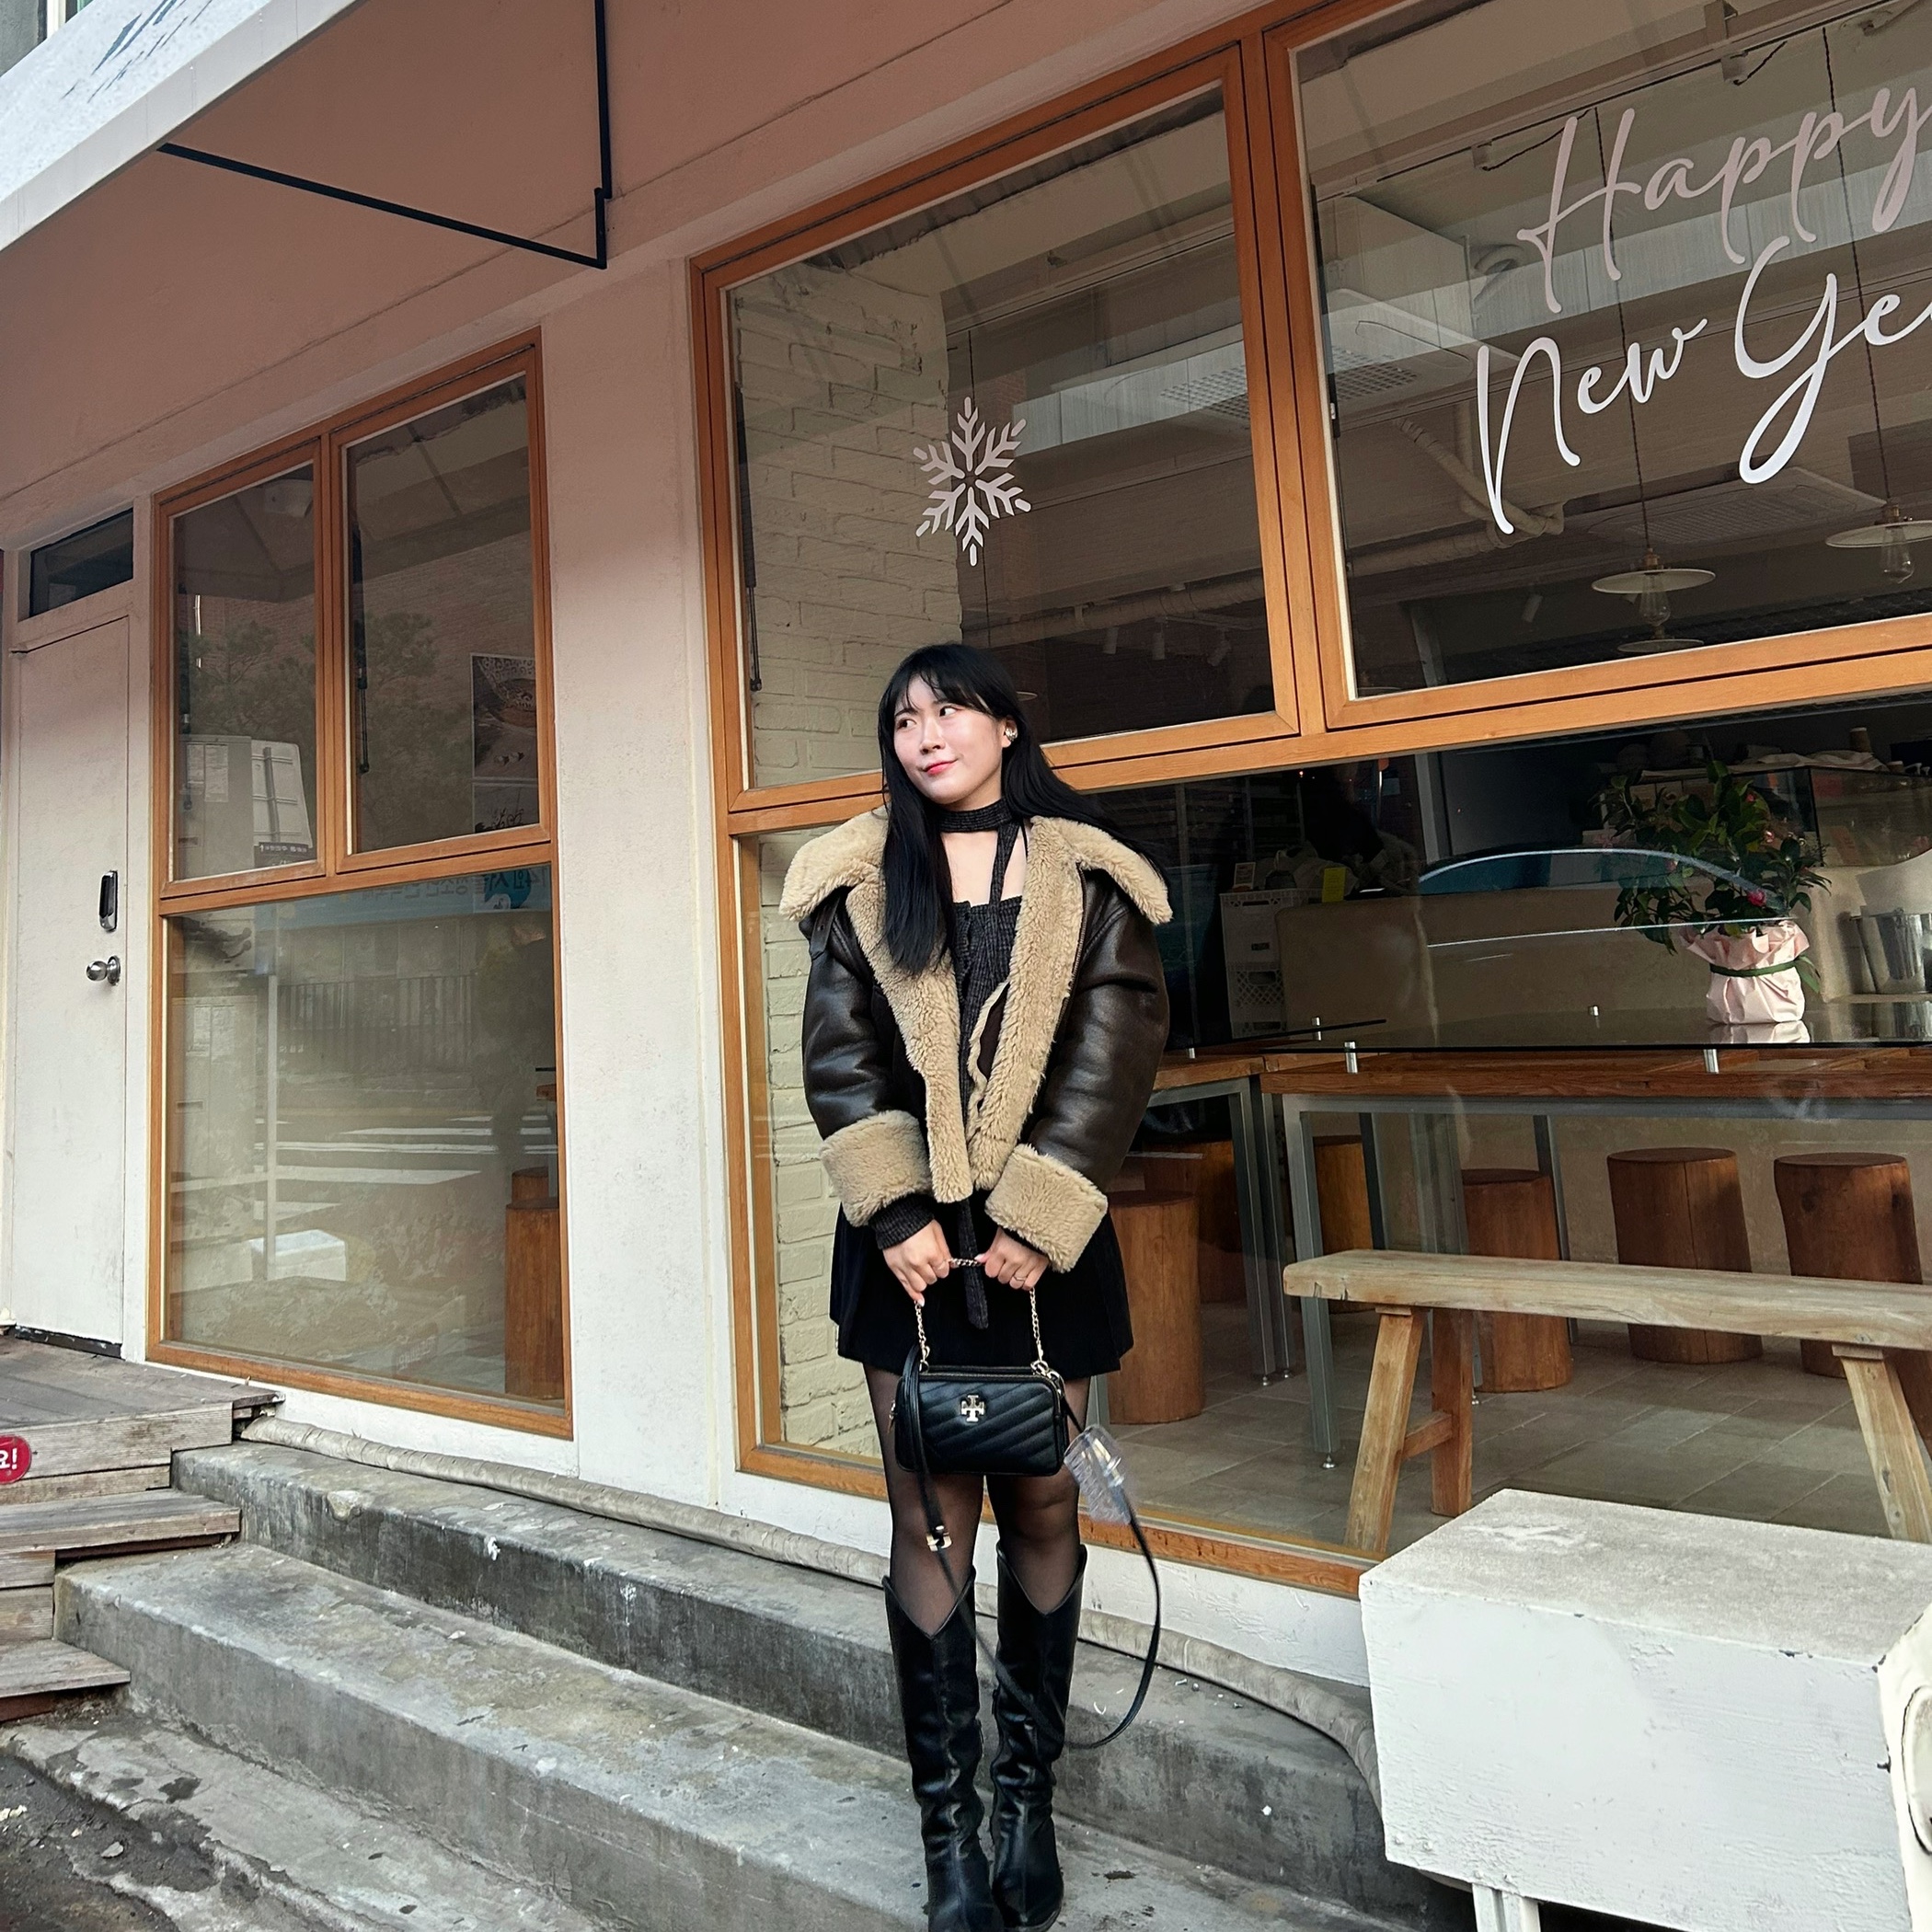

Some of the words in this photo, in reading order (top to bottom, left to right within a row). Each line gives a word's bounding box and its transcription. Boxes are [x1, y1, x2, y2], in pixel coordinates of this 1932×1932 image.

[1516, 87, 1932, 313] Happy
[1477, 318, 1708, 534] New
[1735, 236, 1932, 484] Ye
